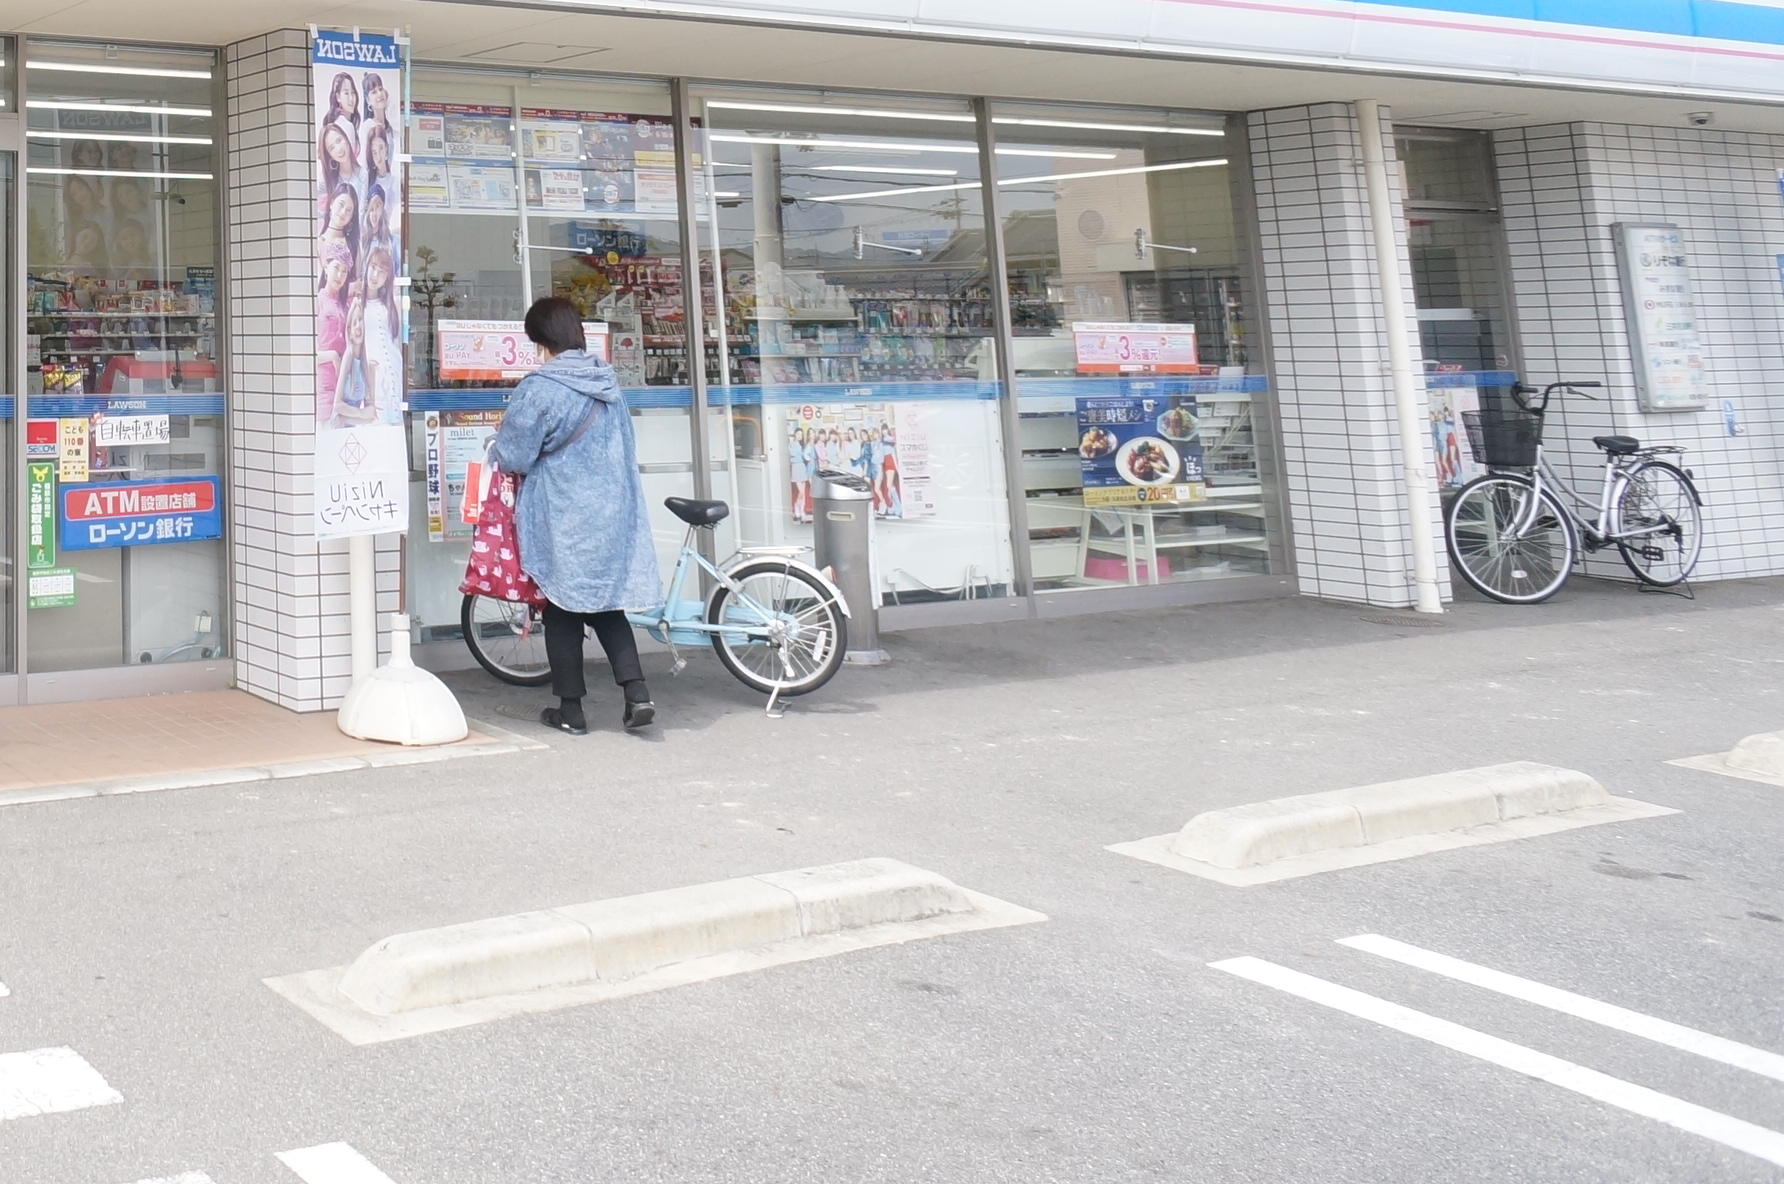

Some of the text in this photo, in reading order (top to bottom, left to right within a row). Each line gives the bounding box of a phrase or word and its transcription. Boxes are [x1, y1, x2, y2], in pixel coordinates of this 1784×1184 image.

[107, 400, 147, 409] LAWSON
[459, 412, 483, 421] Sound
[64, 426, 84, 434] こども
[100, 418, 170, 441] 自転車置場
[449, 428, 475, 437] milet
[63, 437, 84, 446] 110番
[27, 444, 56, 453] SECOM
[427, 432, 440, 495] プロ野球
[83, 490, 197, 516] ATM設置店舗
[88, 516, 194, 544] ローソン銀行
